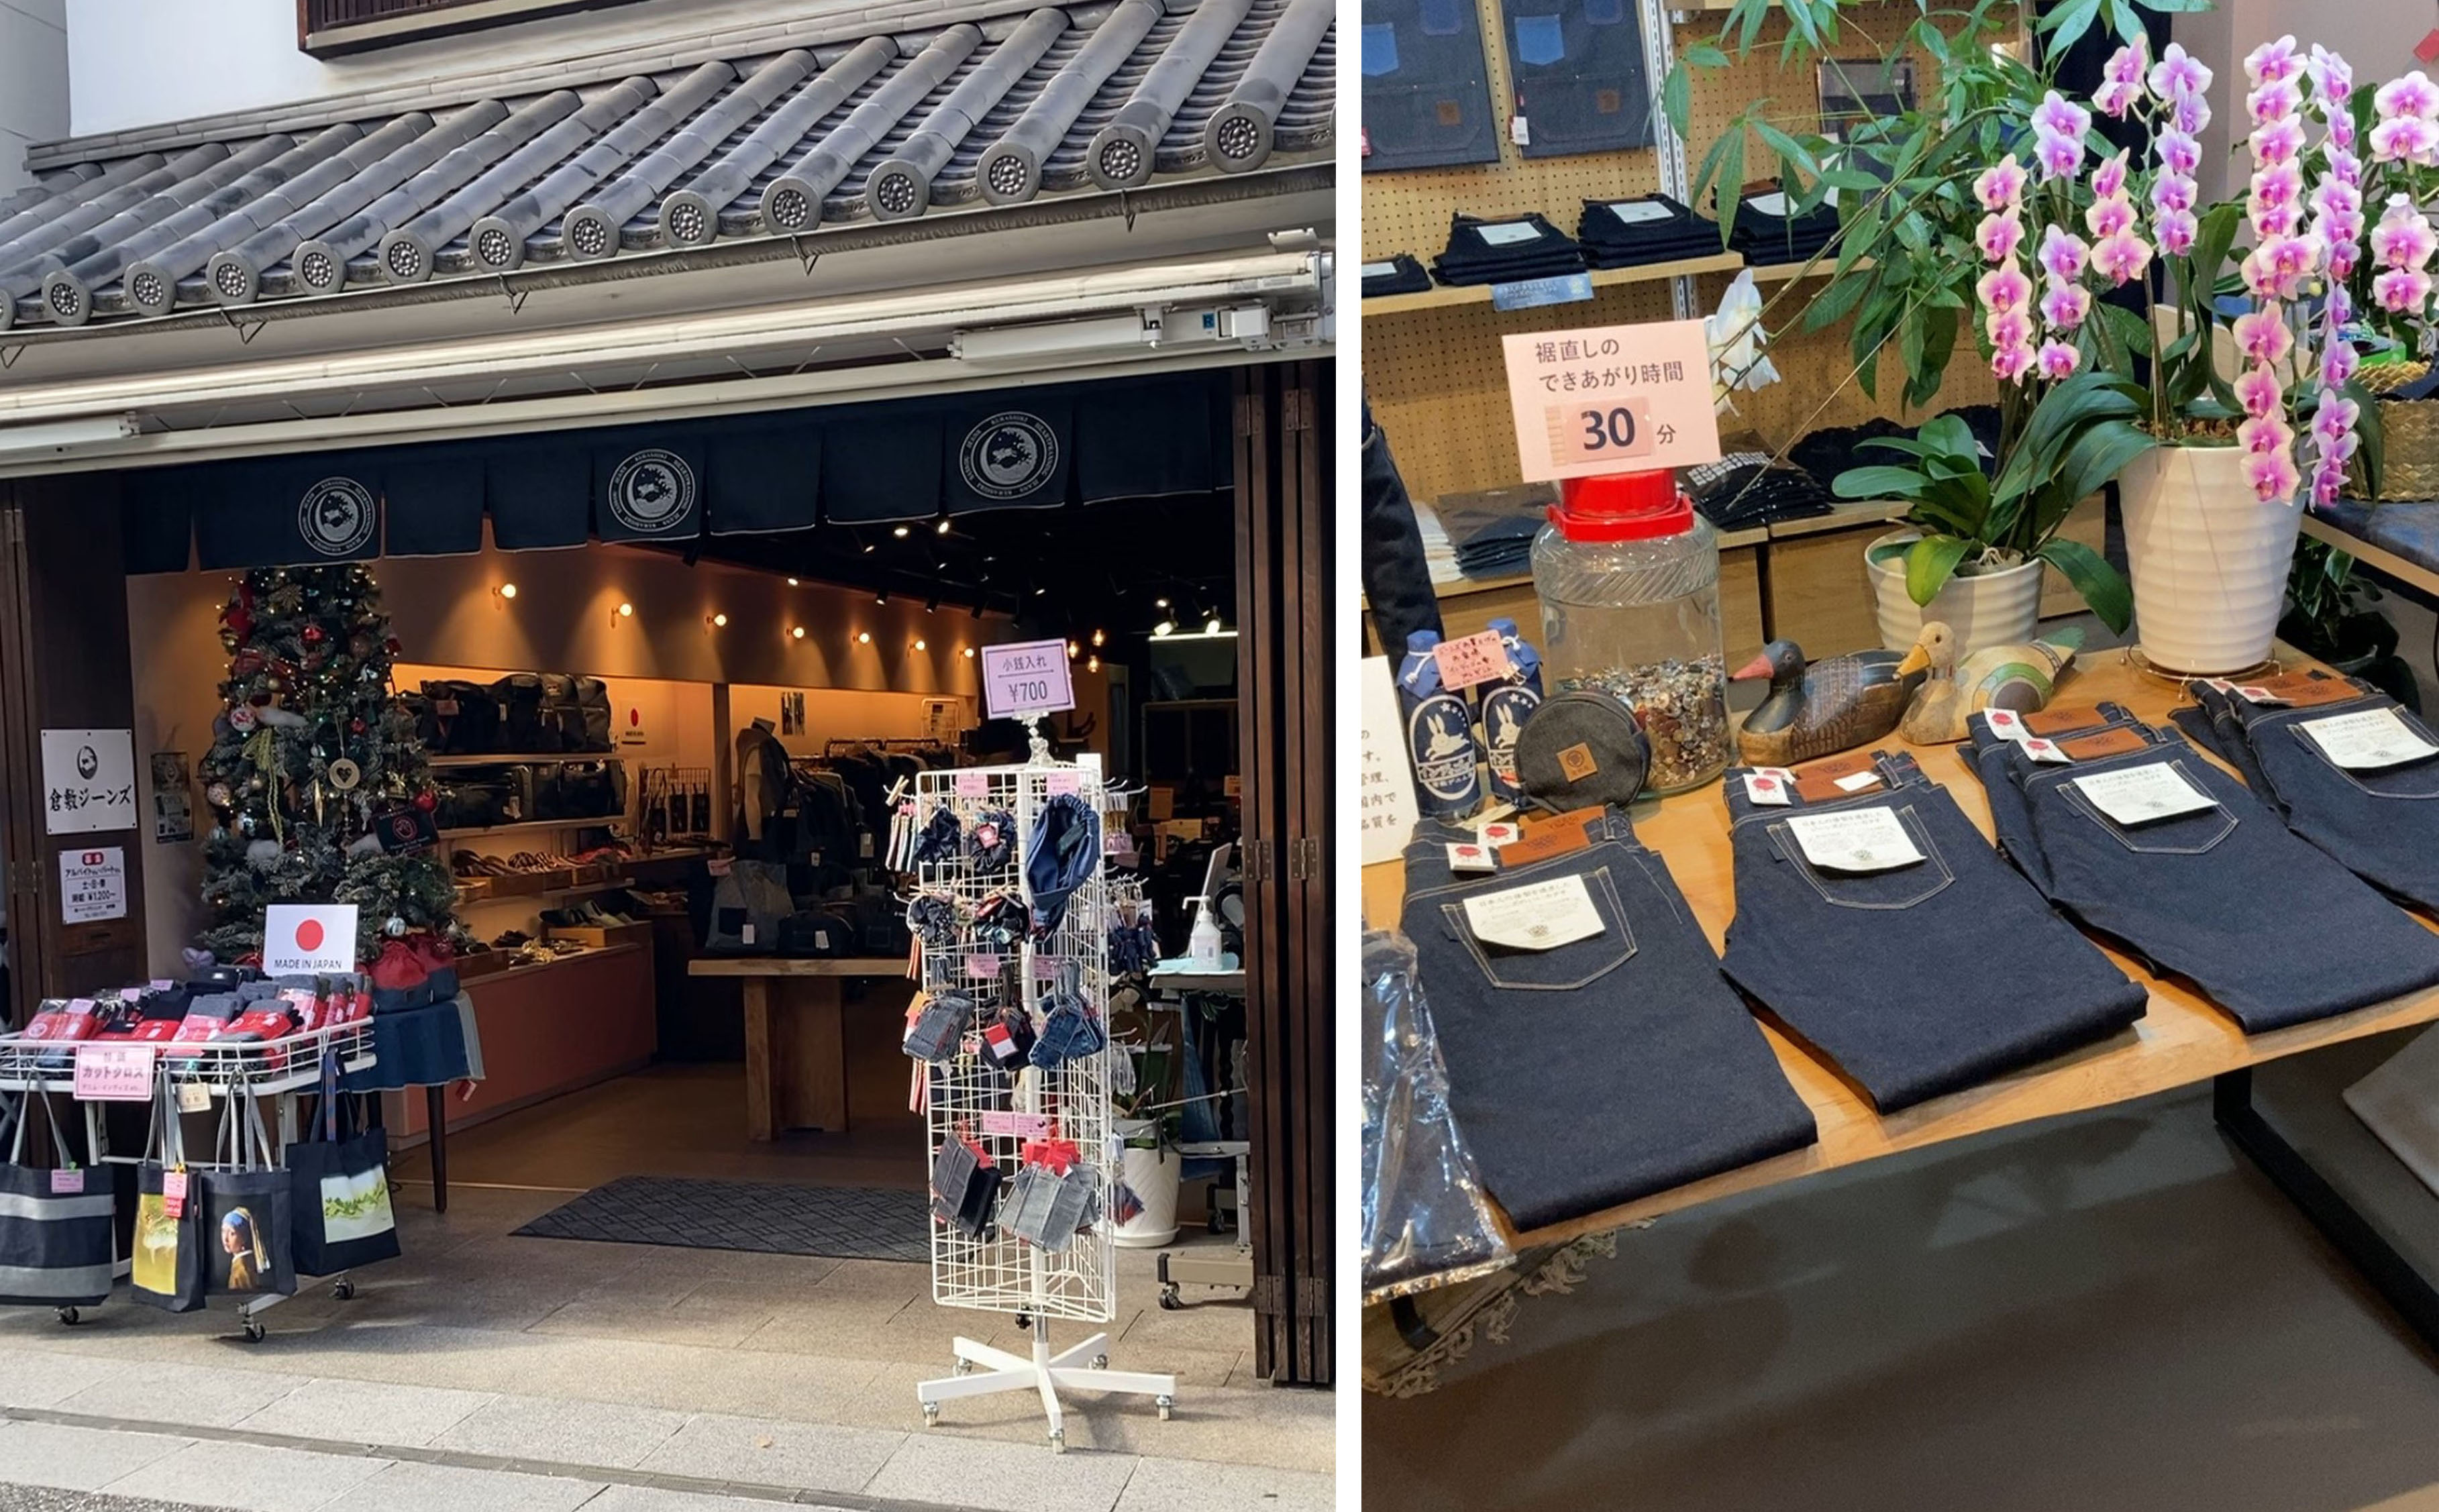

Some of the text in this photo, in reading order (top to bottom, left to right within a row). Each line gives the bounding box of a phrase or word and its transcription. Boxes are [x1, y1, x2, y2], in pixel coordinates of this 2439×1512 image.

[1535, 339, 1620, 364] 裾直しの
[1539, 361, 1684, 392] できあがり時間
[1581, 407, 1677, 450] 30 分
[1002, 655, 1047, 671] 小銭入れ
[1008, 680, 1048, 702] ¥700
[49, 784, 133, 812] 倉敷ジーンズ
[274, 959, 342, 969] MADE IN JAPAN
